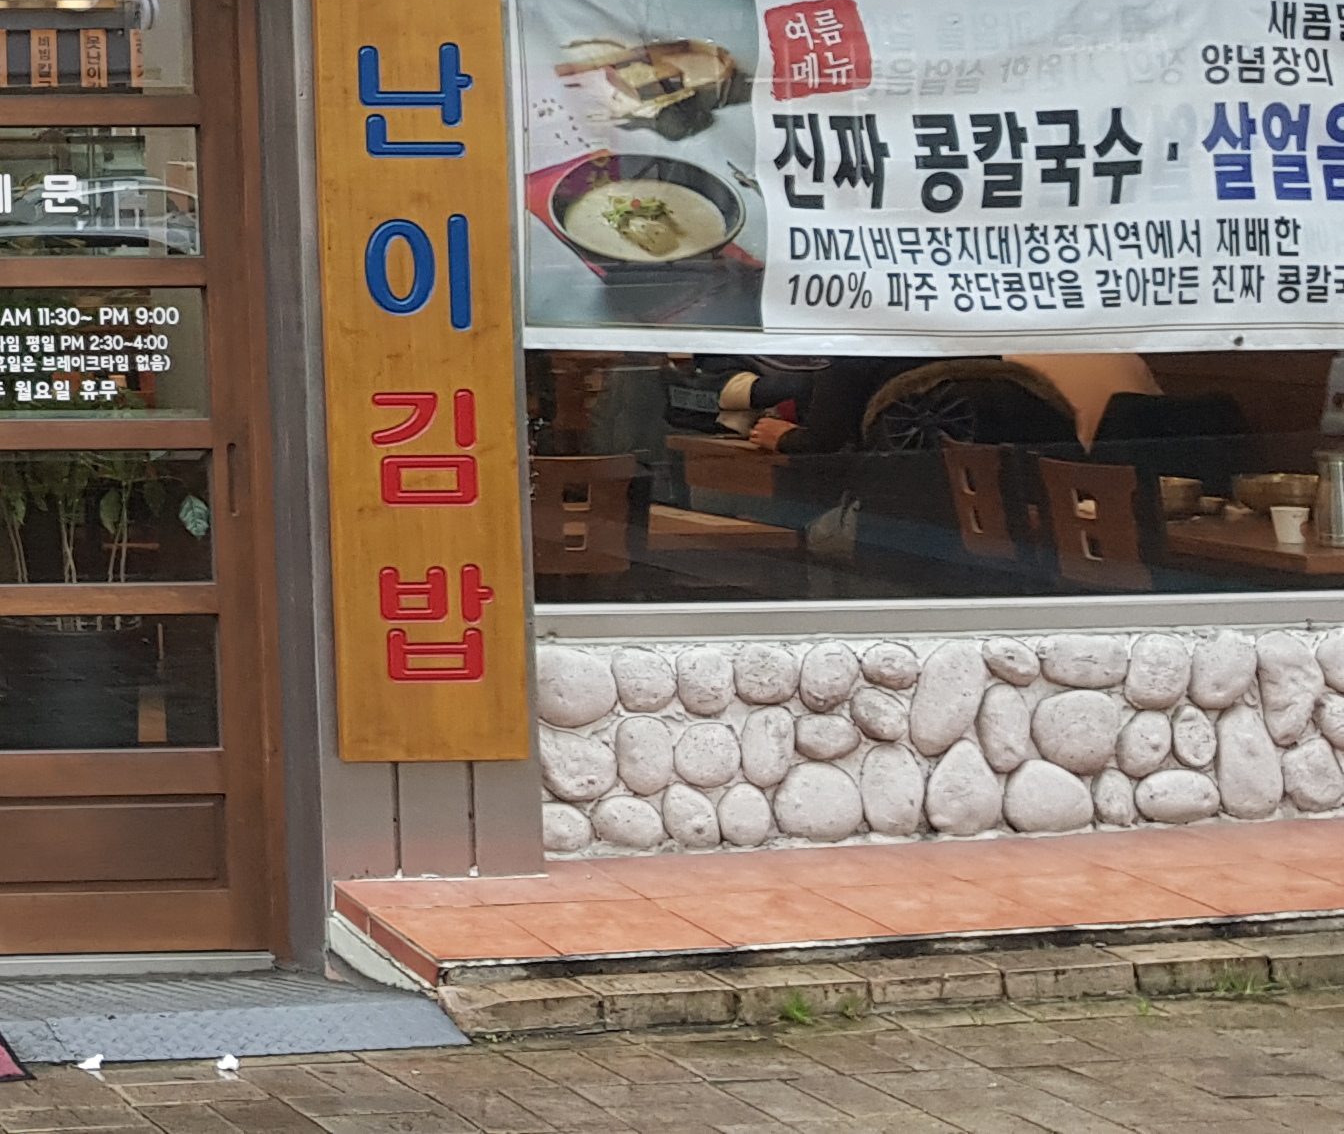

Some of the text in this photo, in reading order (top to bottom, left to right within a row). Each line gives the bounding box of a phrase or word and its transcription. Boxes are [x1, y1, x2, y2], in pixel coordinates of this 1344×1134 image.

[785, 9, 844, 50] 여름
[791, 52, 854, 89] 메뉴
[1202, 45, 1334, 86] 양념장의
[772, 112, 890, 210] 진짜
[912, 107, 1143, 214] 콩칼국수
[1216, 216, 1301, 257] 재배한
[788, 271, 872, 309] 100%
[887, 272, 938, 312] 파주
[948, 269, 1085, 312] 장단콩만을
[1096, 265, 1200, 308] 갈아만든
[1212, 265, 1264, 304] 진짜
[0, 309, 32, 326] AM
[99, 308, 129, 325] PM
[135, 307, 179, 325] 9:00
[26, 335, 55, 353] 평일
[61, 336, 84, 350] PM
[89, 334, 168, 351] 2:30~4:00
[42, 355, 129, 373] 브레이크타임
[136, 355, 171, 372] 없음)
[15, 380, 70, 401] 월요일
[80, 380, 118, 401] 휴무
[371, 388, 493, 684] 김밥
